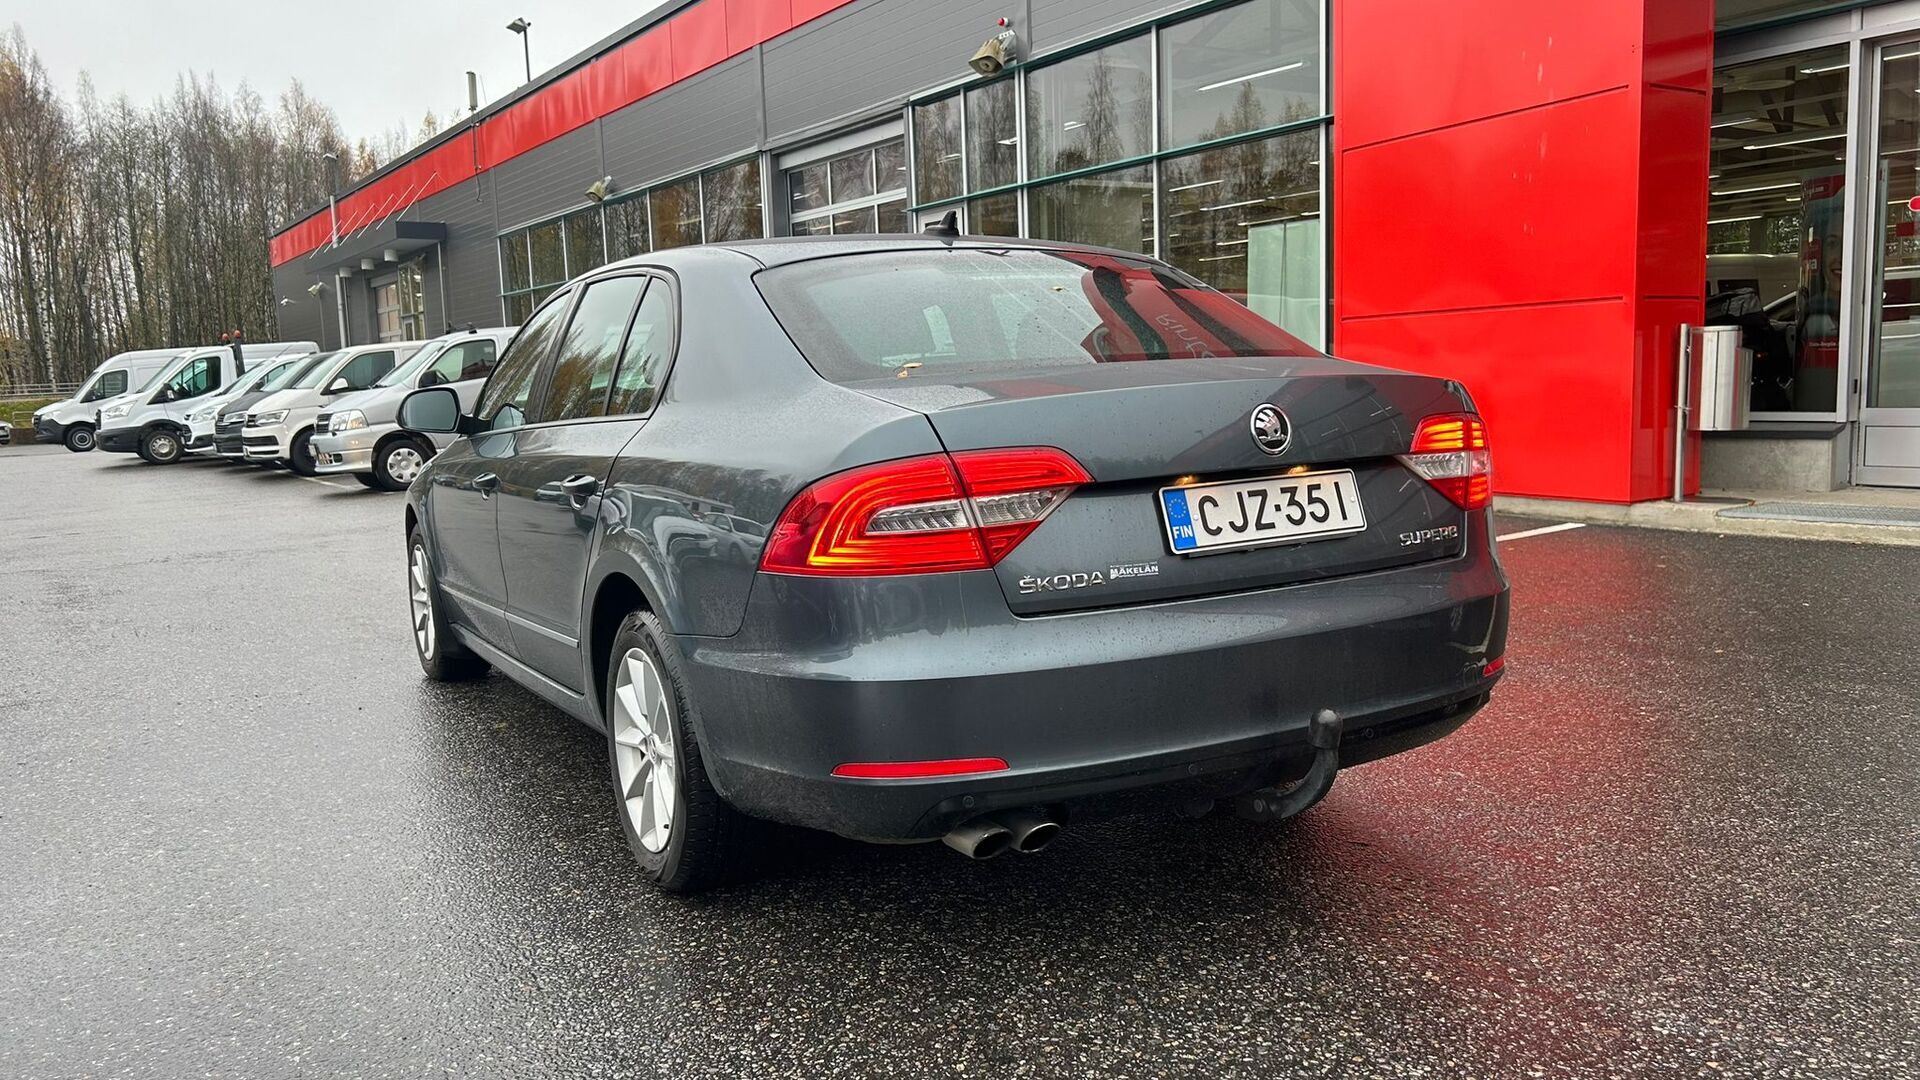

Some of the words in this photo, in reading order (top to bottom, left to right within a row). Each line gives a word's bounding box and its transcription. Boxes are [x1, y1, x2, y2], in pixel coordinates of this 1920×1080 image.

[1198, 482, 1347, 536] CJZ-351
[1172, 524, 1194, 539] FIN
[1399, 525, 1458, 546] SUPERB
[1018, 570, 1107, 594] ŠKODA
